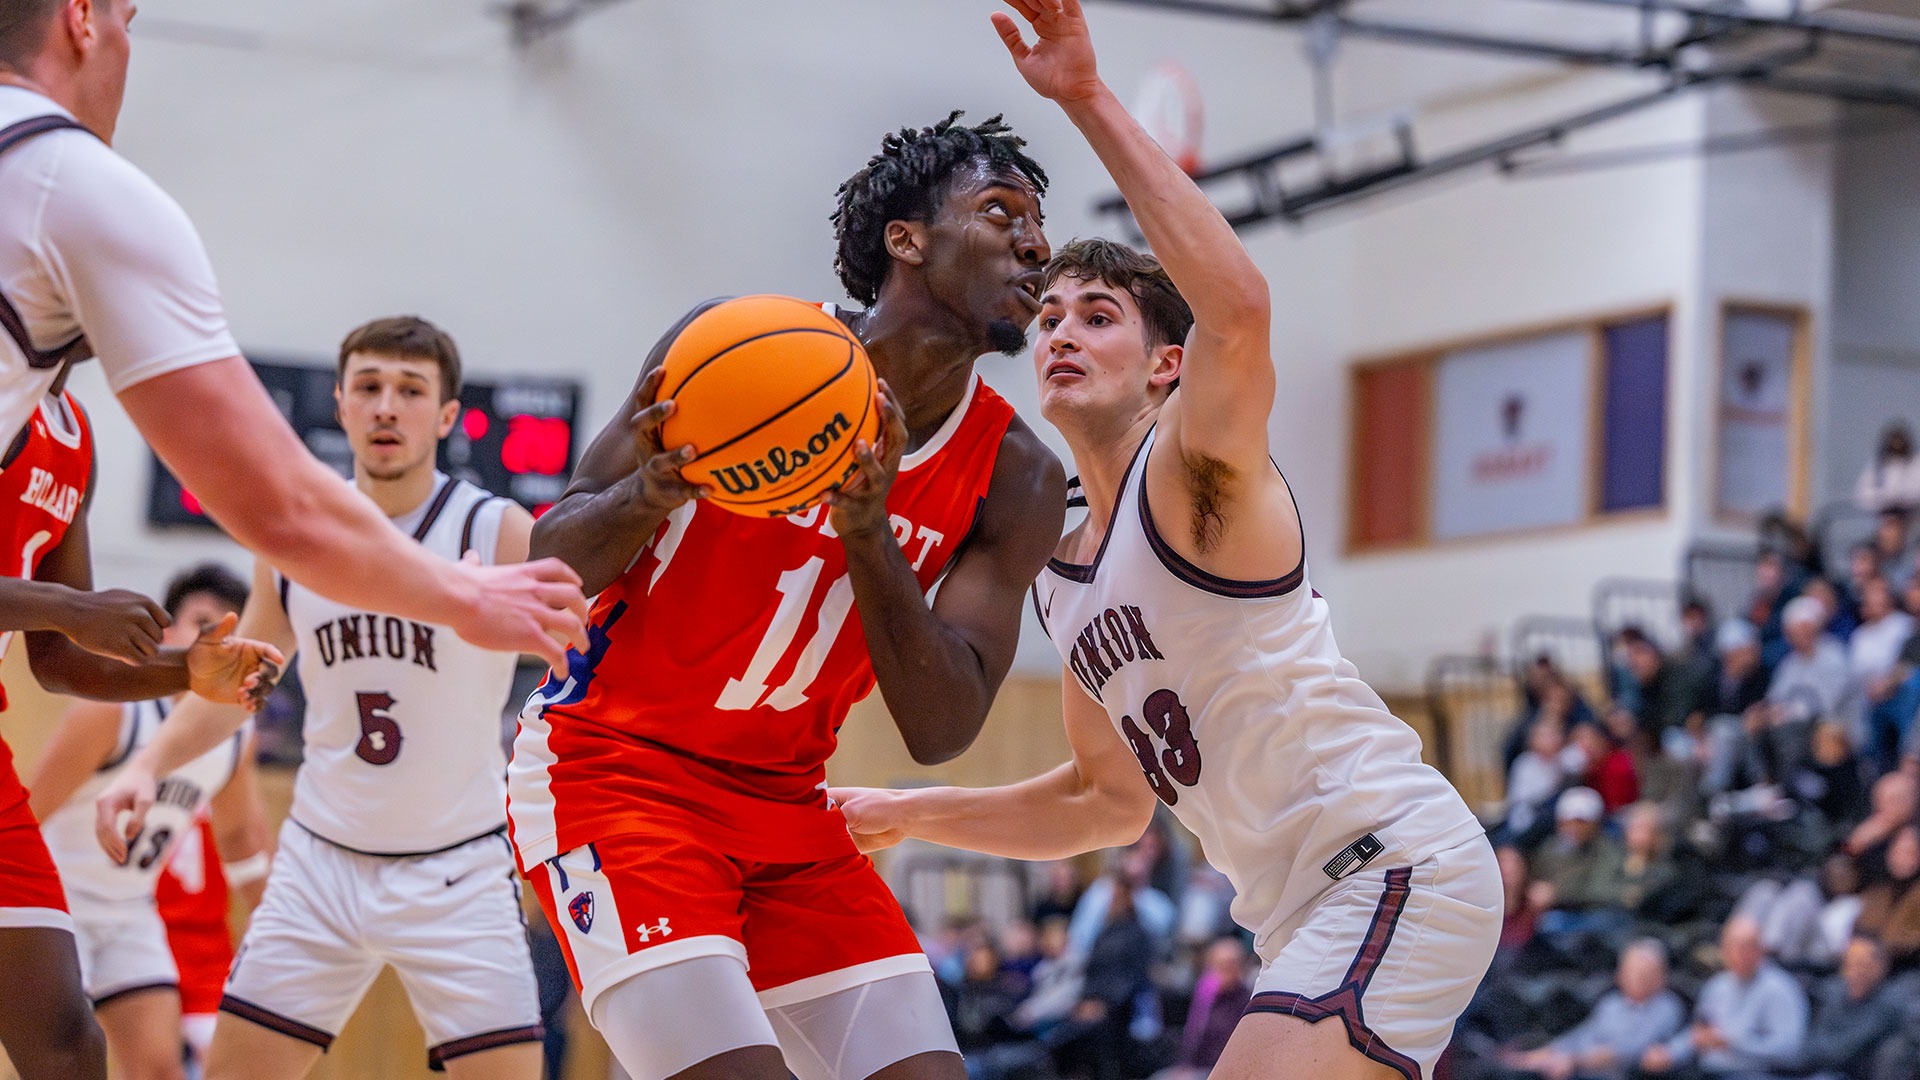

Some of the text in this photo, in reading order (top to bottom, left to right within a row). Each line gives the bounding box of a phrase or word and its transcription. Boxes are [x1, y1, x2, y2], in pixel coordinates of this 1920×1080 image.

[709, 411, 852, 495] Wilson
[313, 613, 438, 672] UNION
[715, 555, 856, 712] 11
[1069, 604, 1165, 704] UNION
[354, 691, 404, 766] 5
[1360, 844, 1373, 854] L
